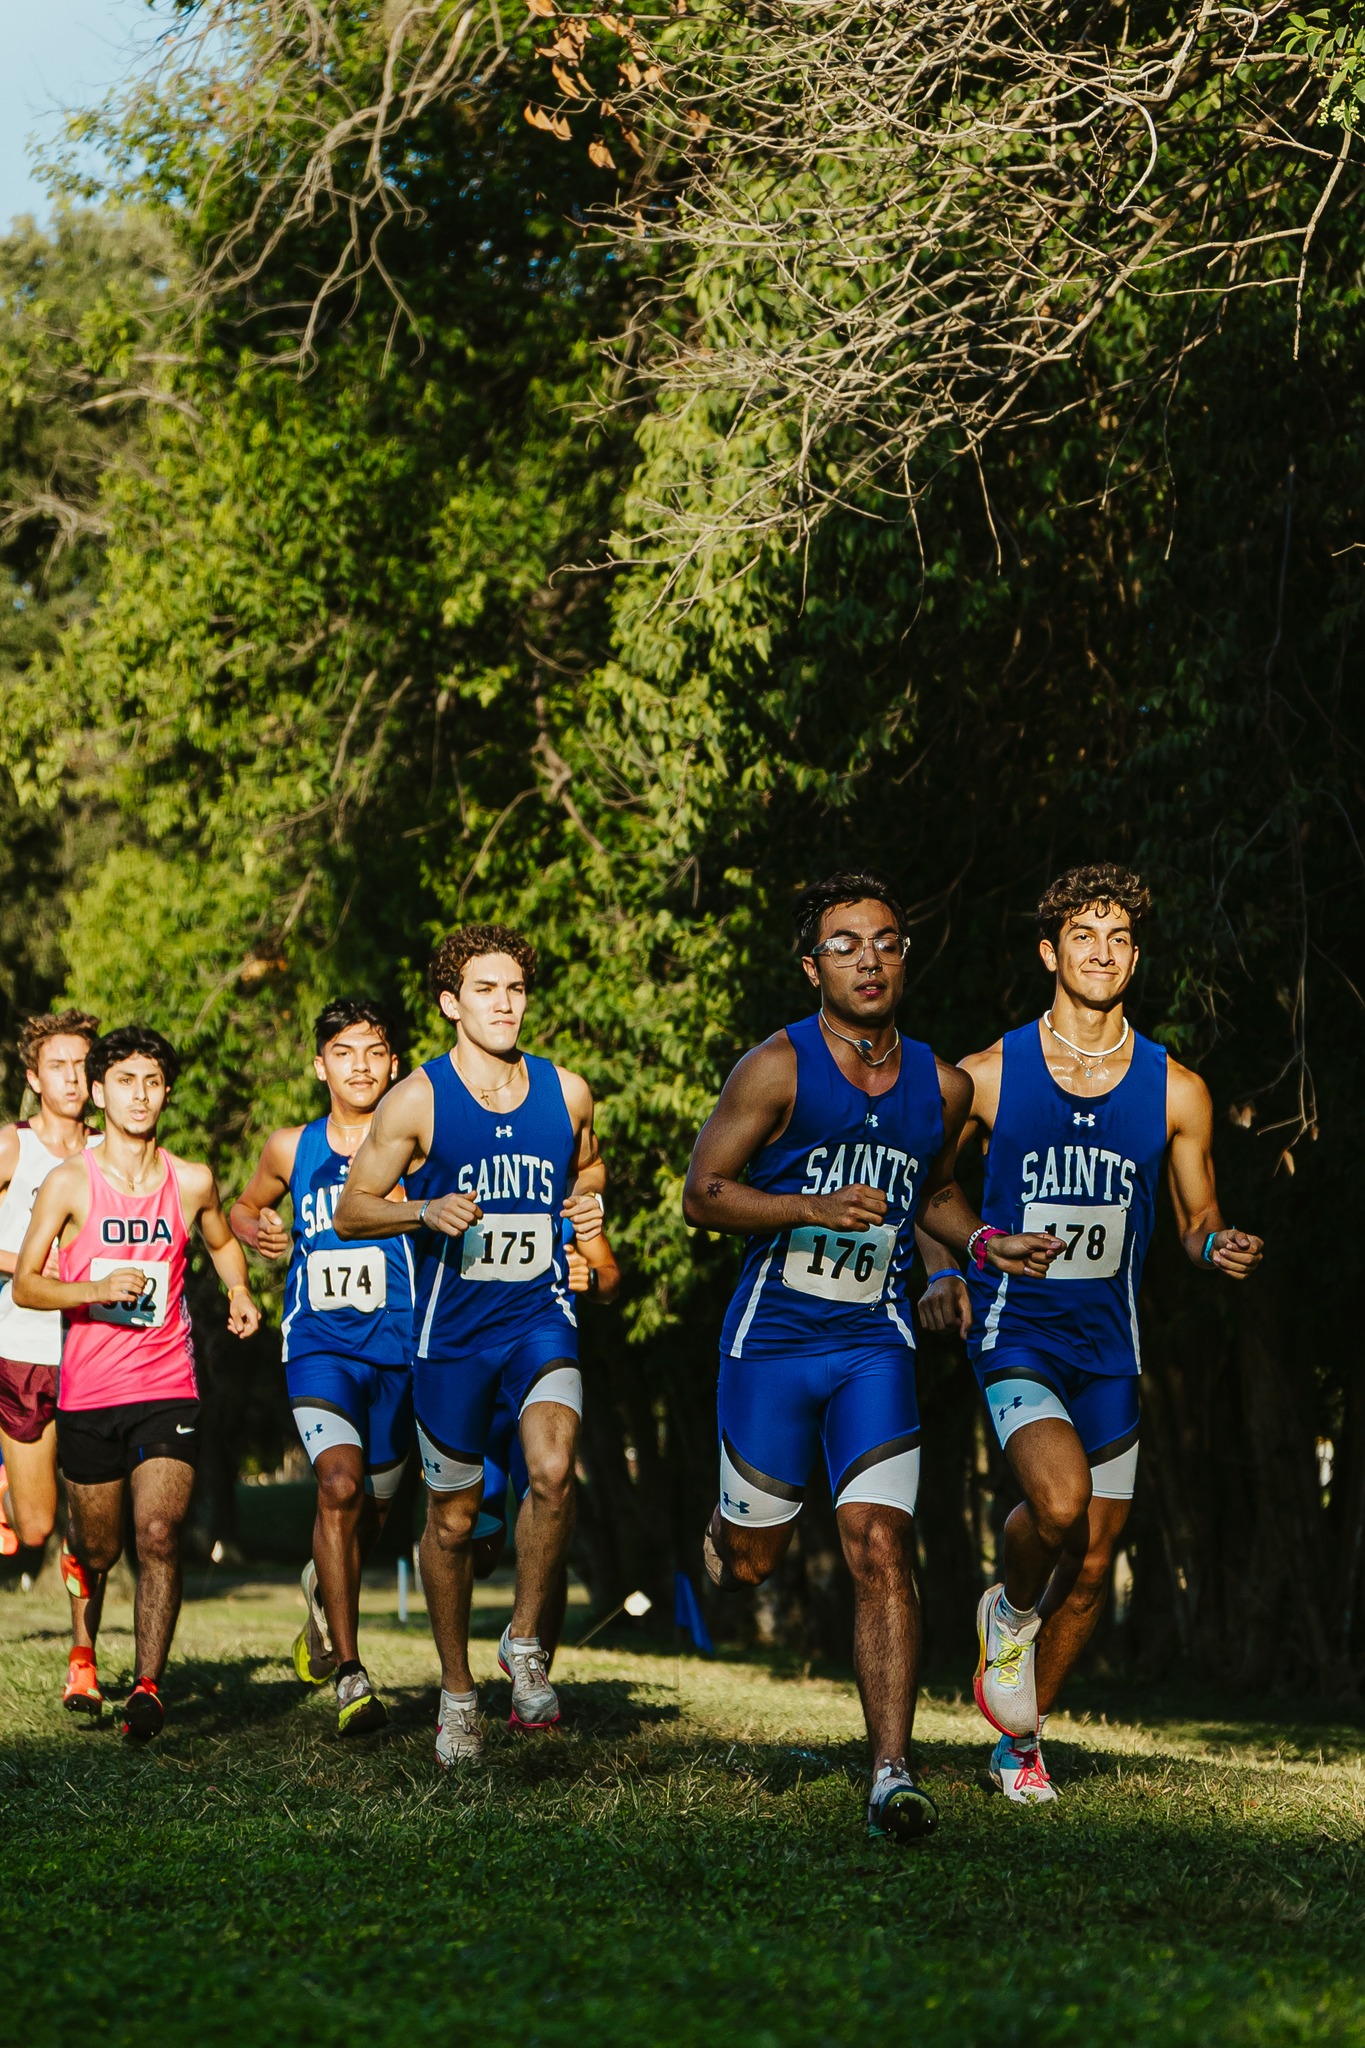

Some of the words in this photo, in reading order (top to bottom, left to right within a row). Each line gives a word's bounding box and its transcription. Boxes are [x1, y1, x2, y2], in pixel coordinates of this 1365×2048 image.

[458, 1154, 554, 1205] SAINTS
[801, 1144, 919, 1211] SAINTS
[1021, 1146, 1136, 1208] SAINTS
[101, 1216, 173, 1246] ODA
[481, 1231, 536, 1265] 175
[322, 1265, 372, 1298] 174
[807, 1234, 878, 1283] 176
